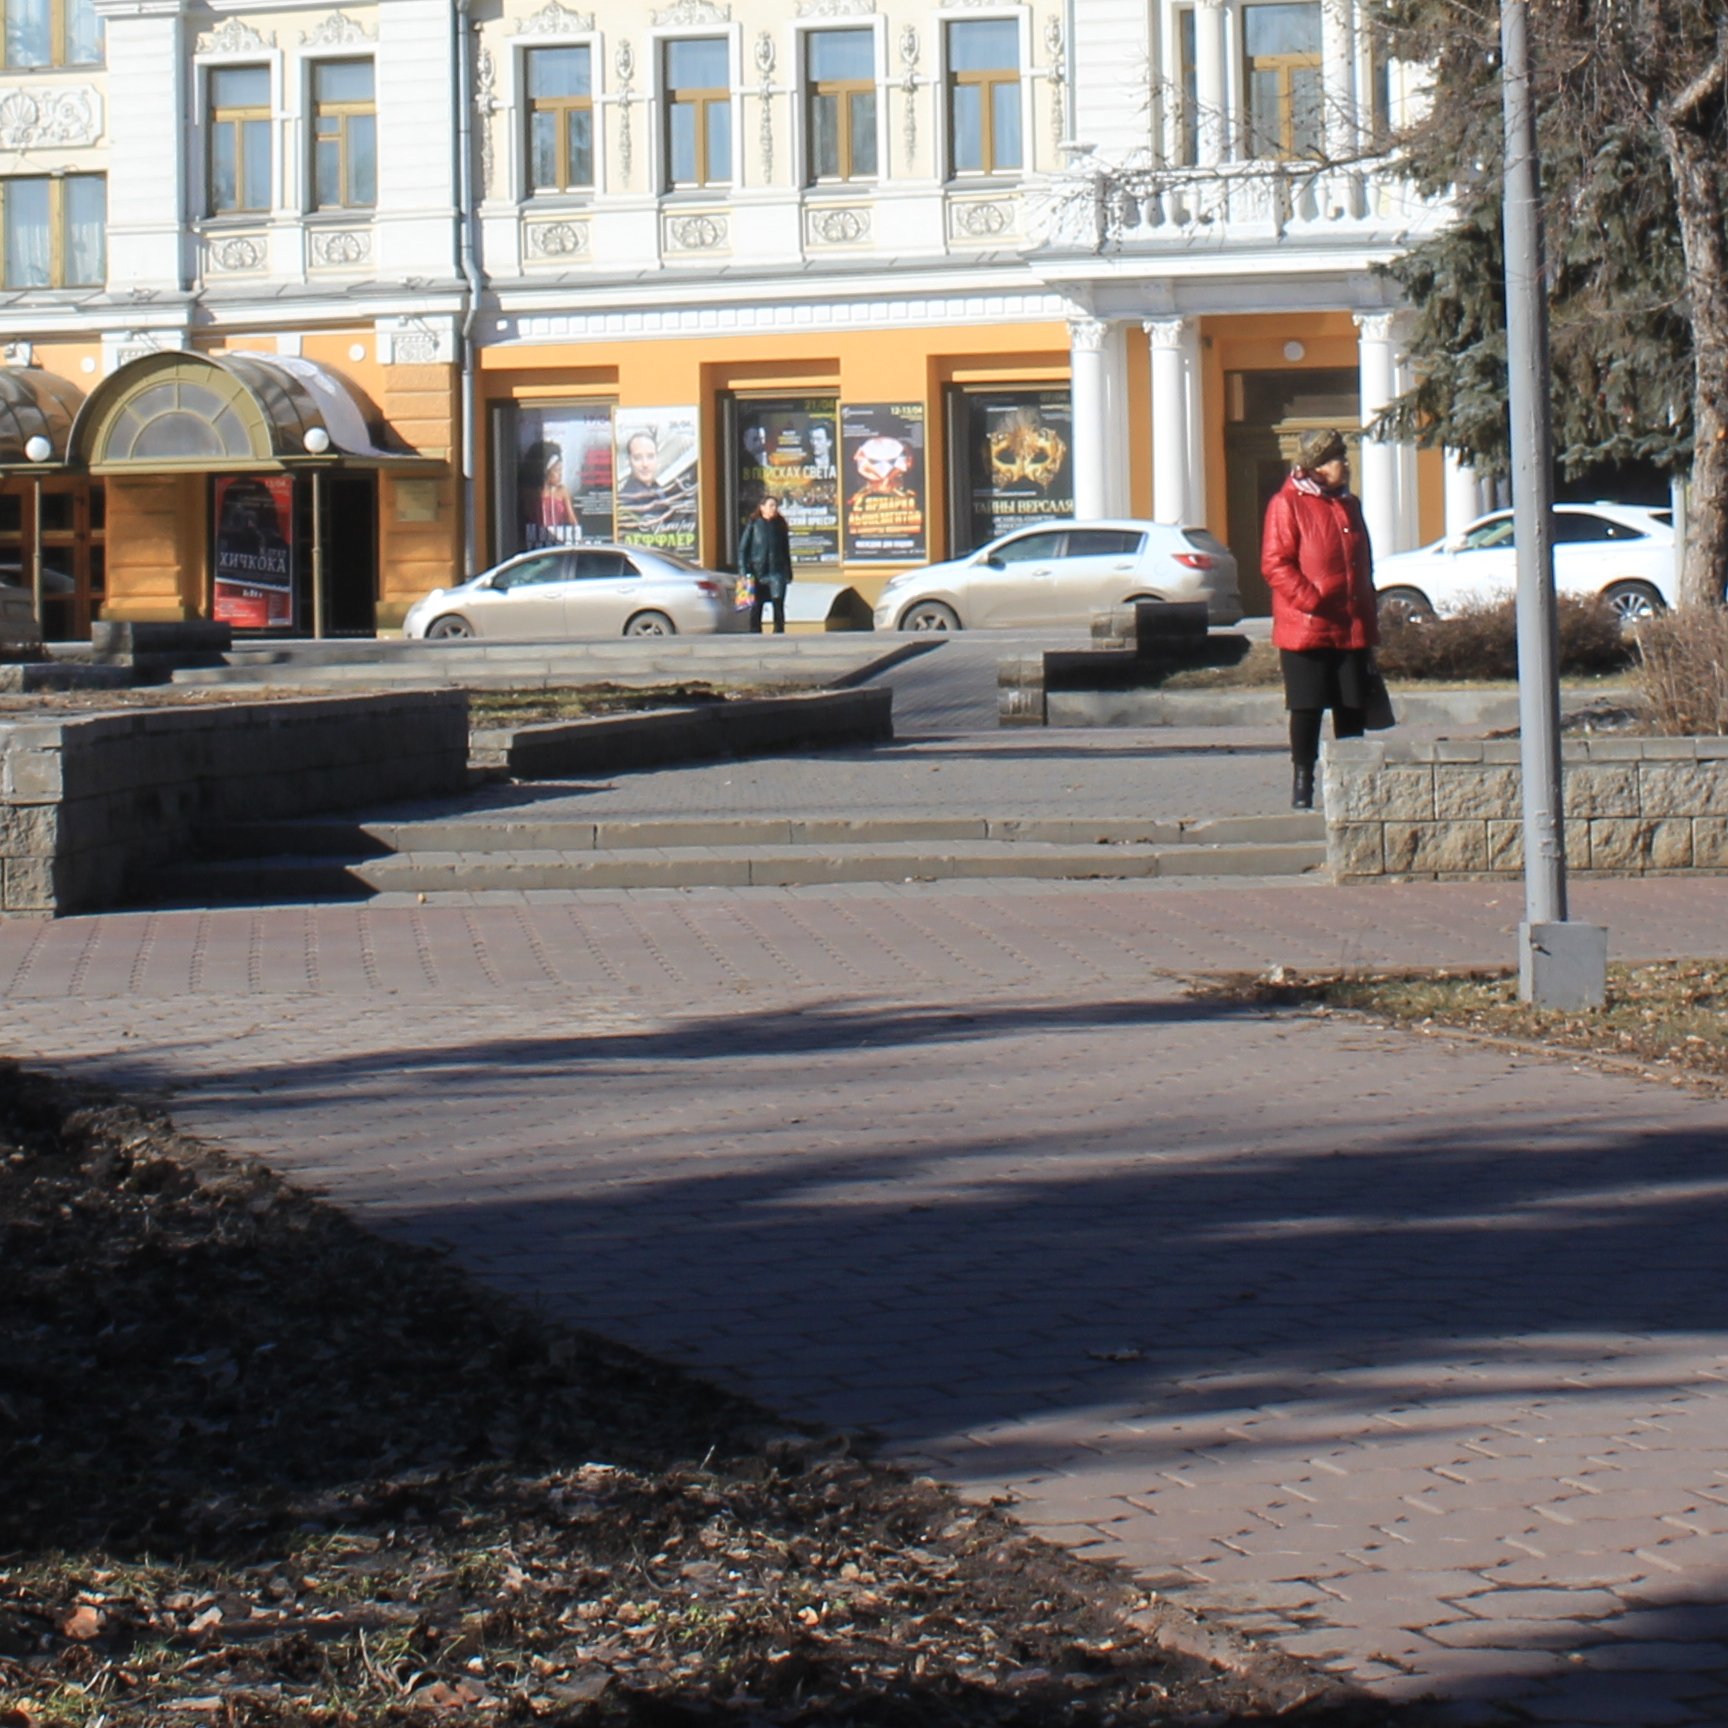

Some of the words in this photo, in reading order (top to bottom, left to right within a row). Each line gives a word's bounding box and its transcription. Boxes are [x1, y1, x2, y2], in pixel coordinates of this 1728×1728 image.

[751, 465, 801, 480] ПОИСКАХ
[802, 464, 837, 479] СВЕТА
[974, 500, 1015, 514] ТАЙНЫ
[1017, 499, 1074, 514] ВЕРСАЛЯ
[624, 532, 695, 547] ЛЕФФЛЕР
[219, 552, 287, 574] ХИЧКОКА
